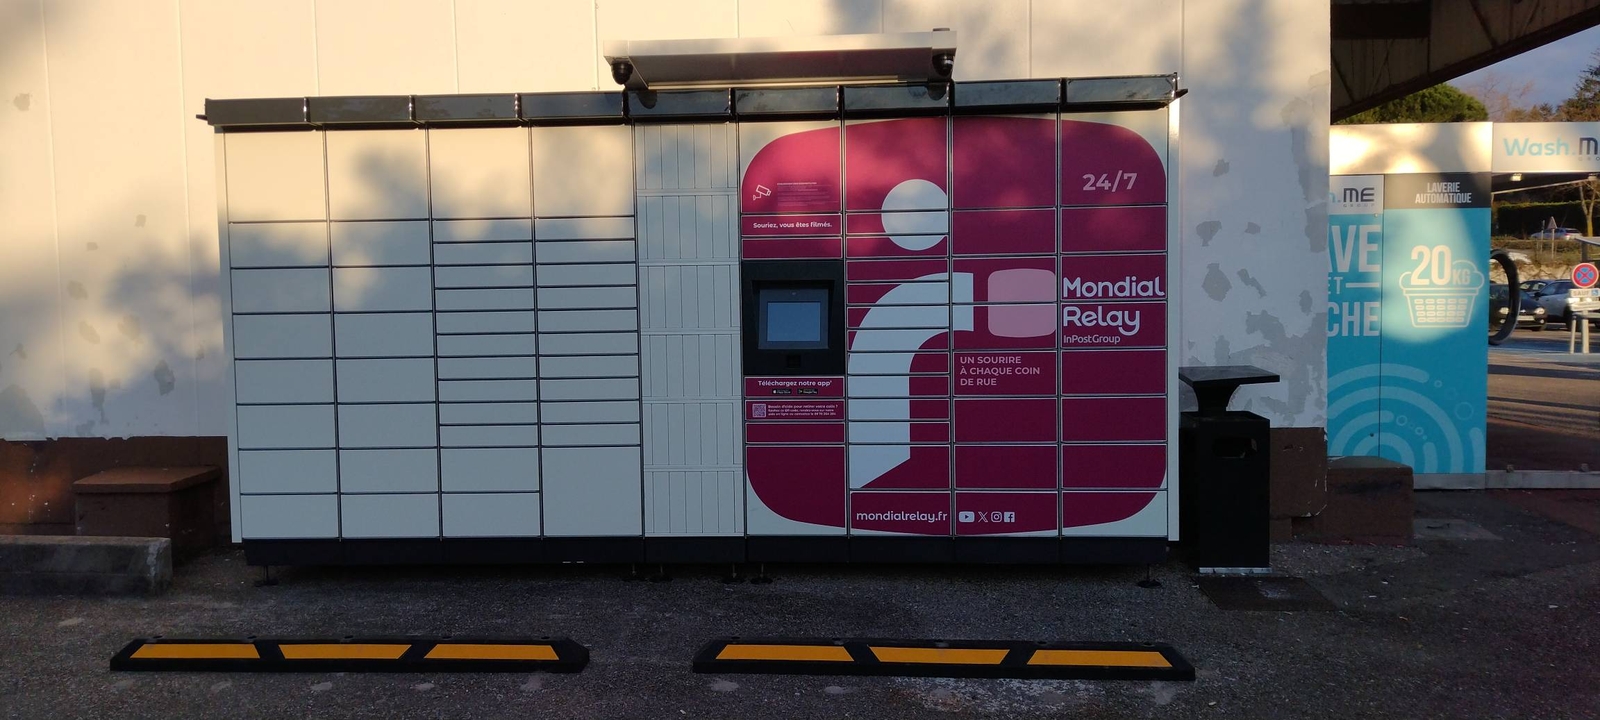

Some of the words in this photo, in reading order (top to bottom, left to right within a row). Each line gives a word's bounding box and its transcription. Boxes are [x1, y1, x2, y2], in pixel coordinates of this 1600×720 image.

[1082, 170, 1137, 192] 24/7
[1427, 182, 1460, 193] LAVERIE
[1415, 193, 1472, 204] AUTOMATIQUE
[1329, 225, 1381, 273] VE
[1063, 276, 1165, 297] Mondial
[1063, 306, 1141, 336] Relay
[960, 356, 975, 364] UN
[977, 356, 1022, 364] SOURIRE
[960, 365, 968, 375] À
[969, 367, 1013, 376] CHAQUE
[1014, 367, 1040, 375] COIN
[960, 378, 974, 386] DE
[976, 378, 997, 386] RUE
[856, 511, 947, 523] mondialrelay.fr
